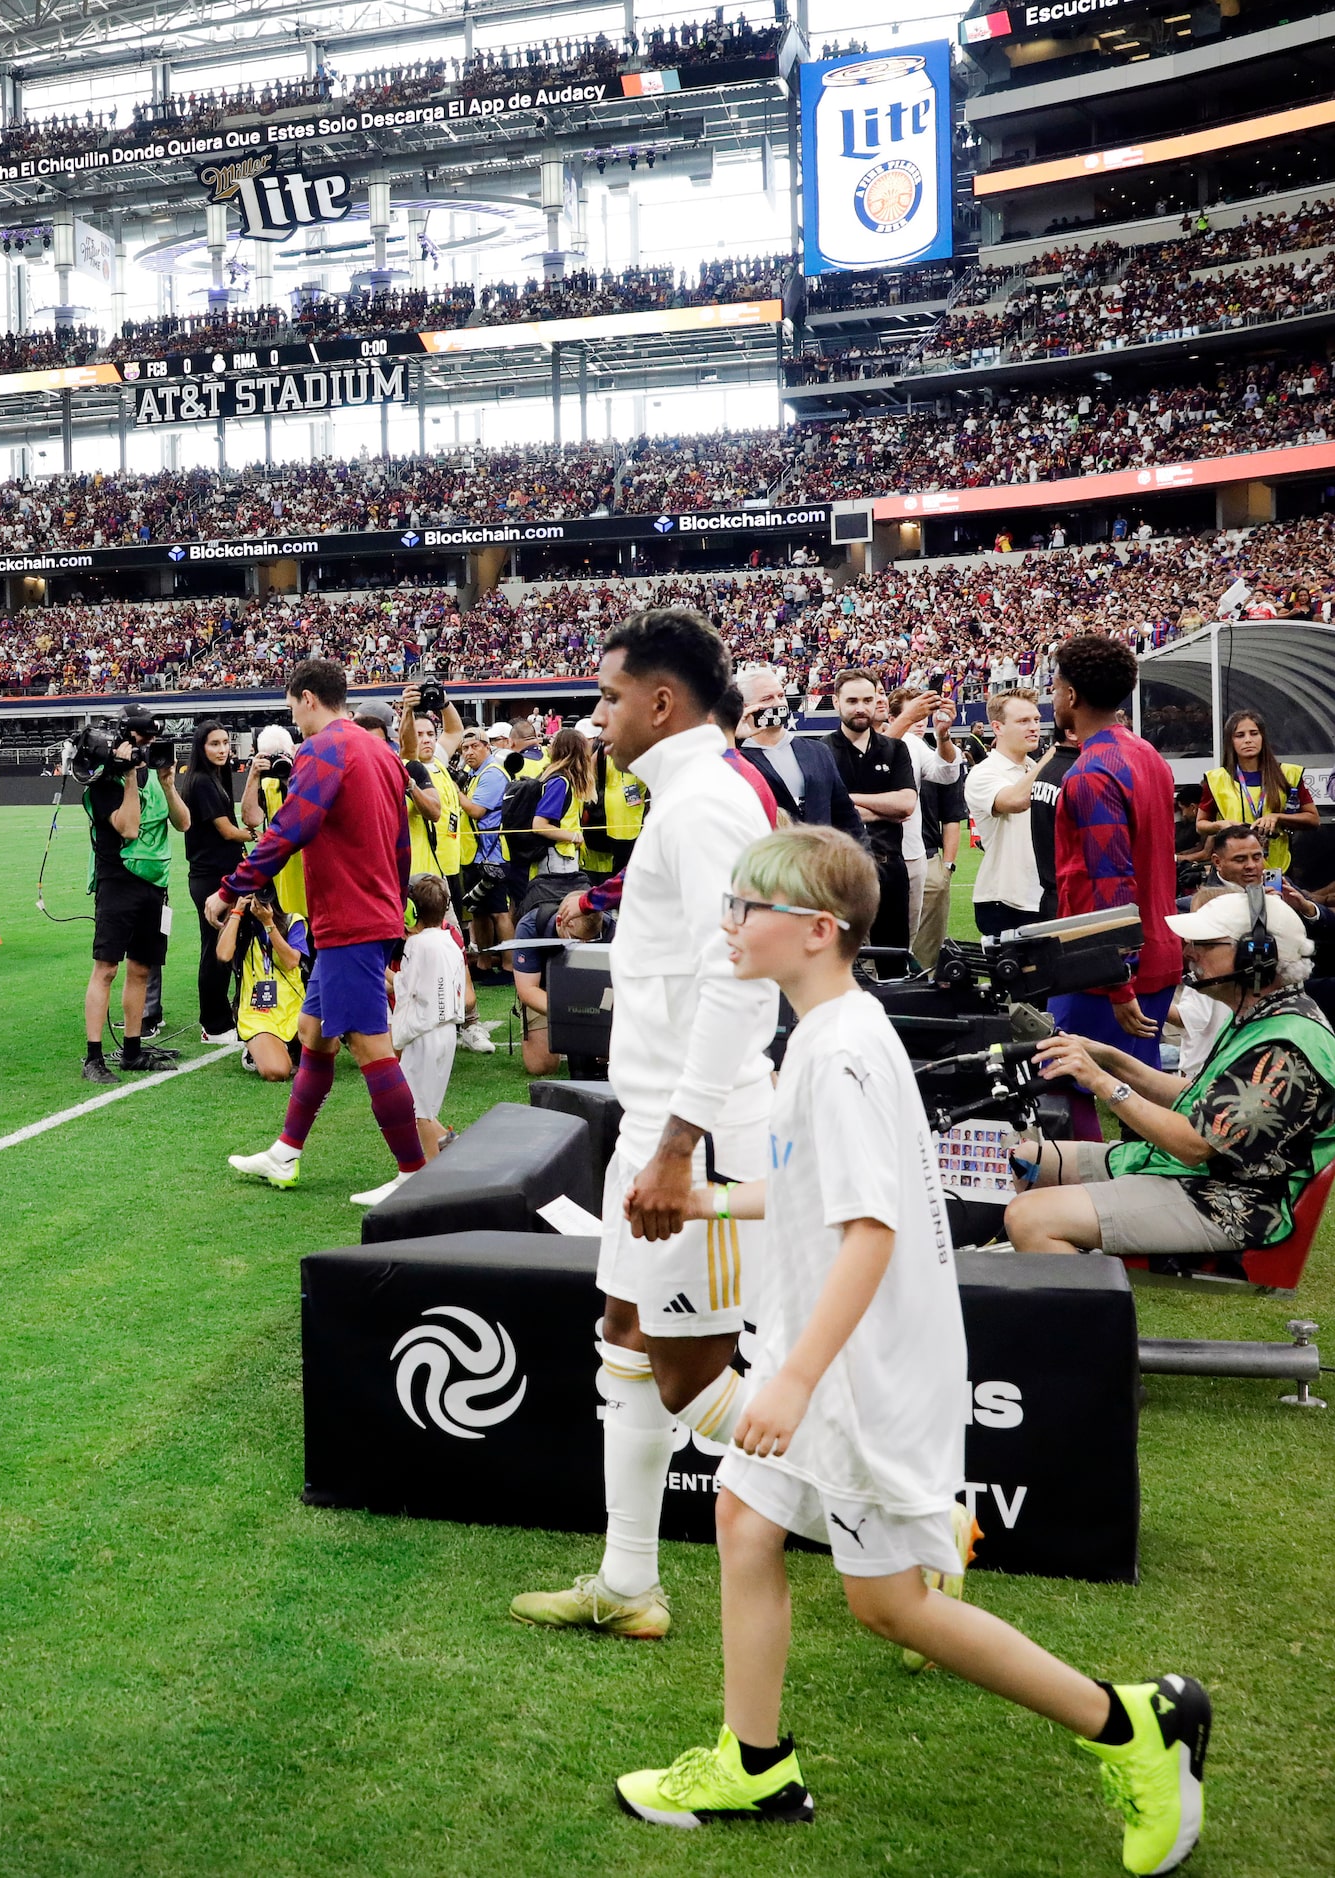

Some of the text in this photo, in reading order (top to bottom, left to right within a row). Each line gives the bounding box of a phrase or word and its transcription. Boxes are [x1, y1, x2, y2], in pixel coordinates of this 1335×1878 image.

[21, 160, 36, 177] El
[38, 153, 110, 175] Chiquilin
[113, 144, 165, 164] Donde
[167, 136, 223, 156] Quiera
[226, 132, 261, 149] Que
[267, 125, 315, 143] Estes
[318, 117, 357, 136] Solo
[362, 106, 444, 129] Descarga
[449, 102, 464, 118] El
[467, 97, 505, 117] App
[508, 92, 531, 109] de
[535, 83, 606, 106] Audacy
[839, 98, 931, 160] Lite
[201, 154, 273, 200] Miller
[232, 173, 348, 240] Lite
[147, 340, 387, 377] FCB 0 RMA 0 0:00
[136, 364, 405, 424] AT&T STADIUM
[424, 523, 564, 547] Blockchain.com
[677, 507, 826, 533] Blockchain.com
[189, 540, 319, 561] Blockchain.com
[917, 1131, 948, 1265] BENEFITING
